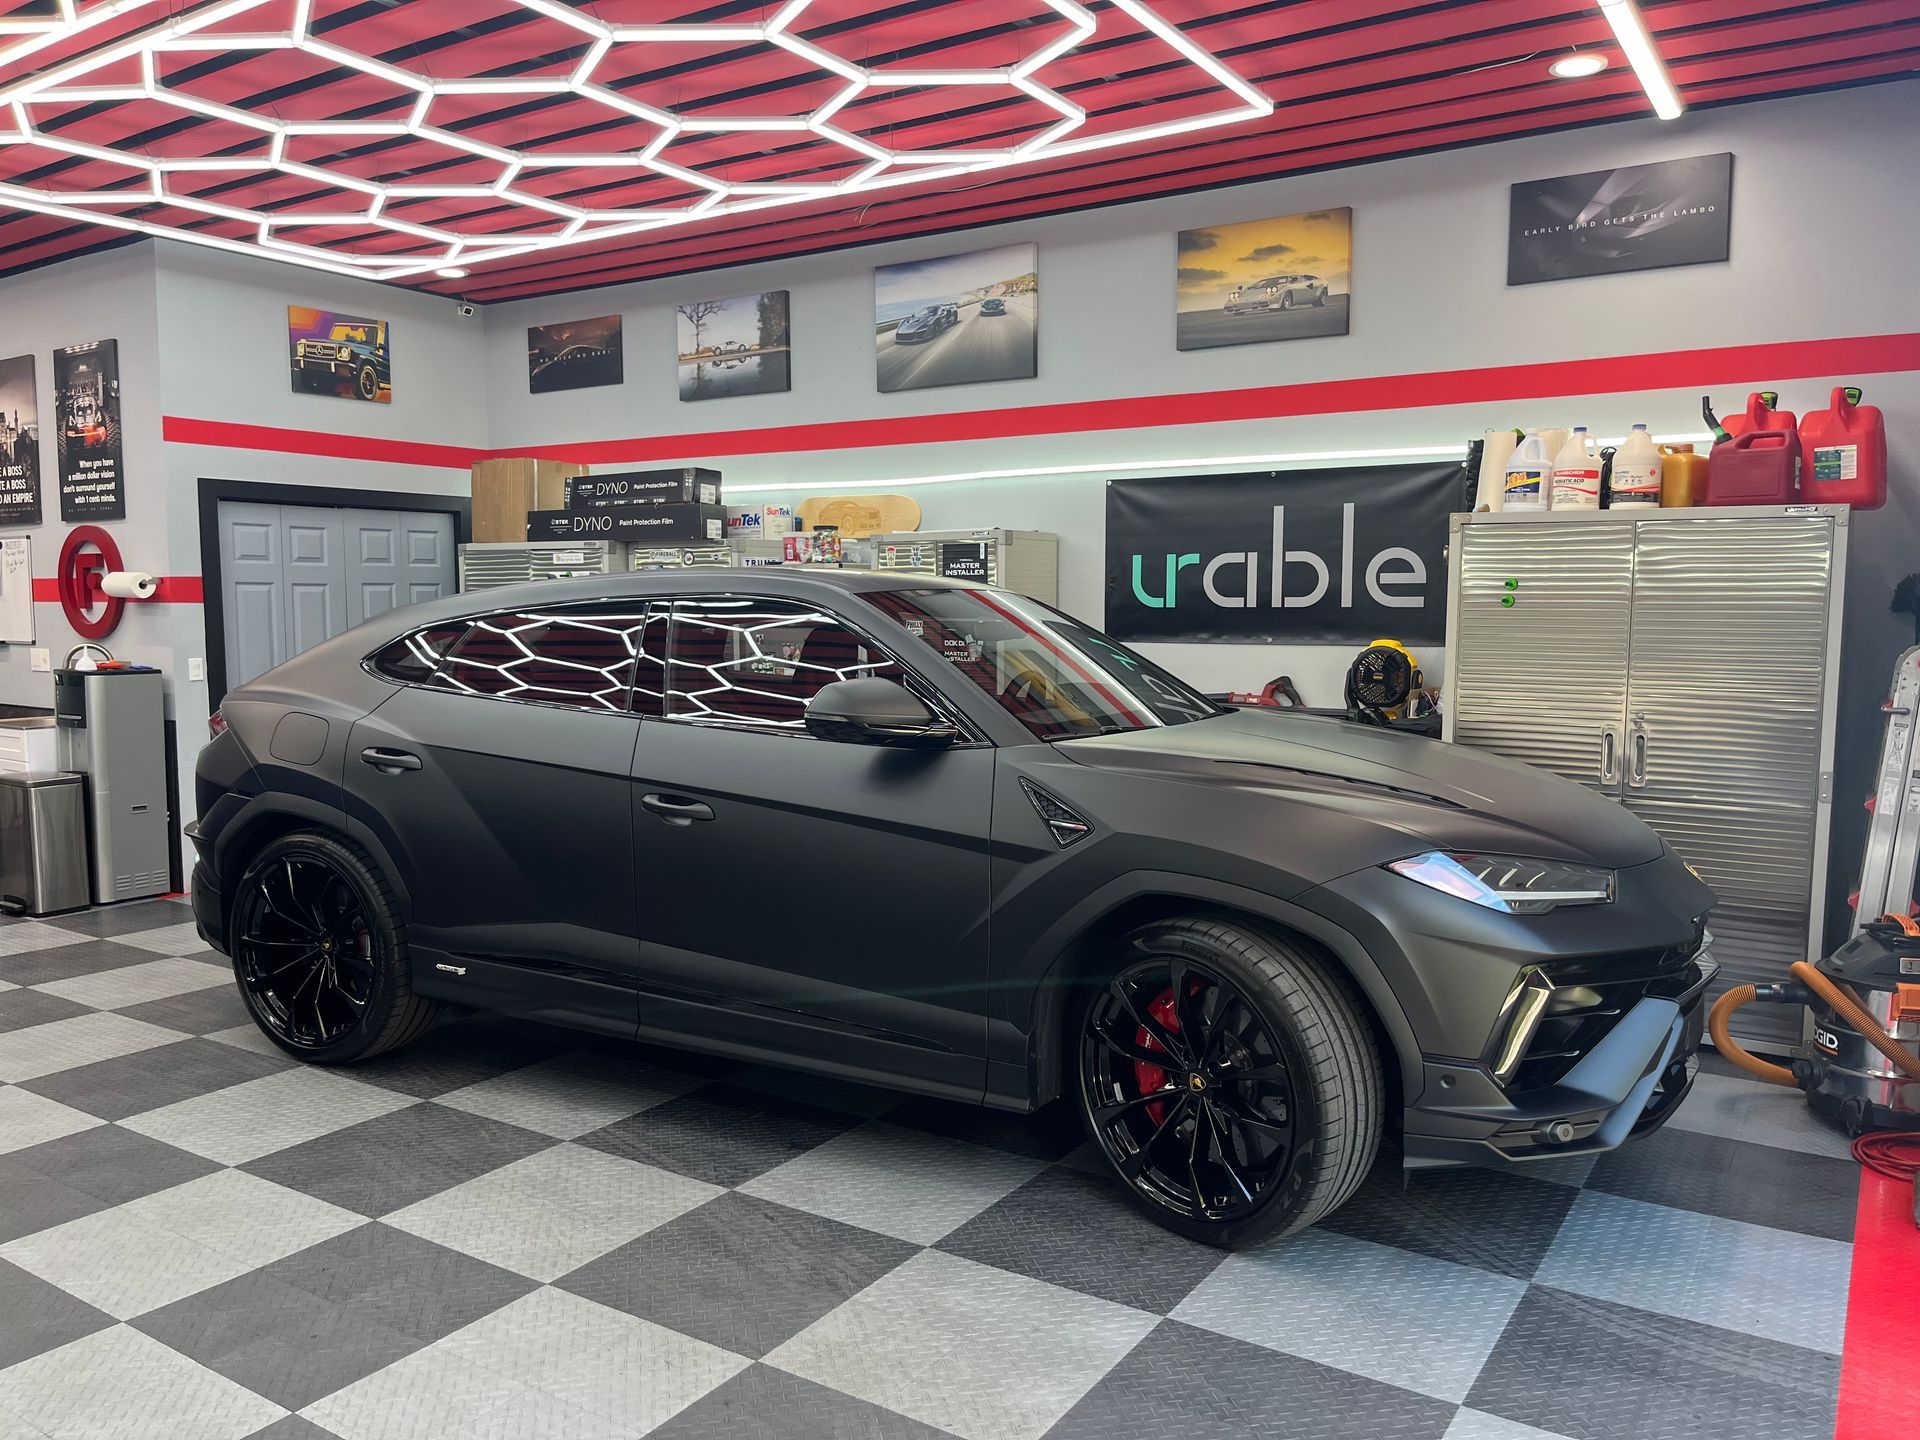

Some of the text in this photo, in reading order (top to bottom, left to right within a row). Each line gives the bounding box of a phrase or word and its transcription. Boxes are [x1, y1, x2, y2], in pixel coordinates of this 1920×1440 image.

[1524, 205, 1715, 236] EARLY BIRD GETS THE LAMBO
[79, 458, 114, 469] When you have
[7, 465, 23, 477] BOSS
[72, 472, 86, 481] million
[87, 470, 100, 479] dollar
[100, 470, 115, 478] vision
[11, 478, 27, 490] BOSS
[76, 483, 96, 492] surround
[96, 481, 116, 493] yourself
[597, 481, 629, 496] DYNO
[646, 481, 668, 489] Protection
[668, 480, 678, 488] Film
[3, 493, 12, 504] AN
[12, 492, 34, 504] EMPIRE
[74, 495, 86, 504] with
[89, 495, 100, 503] cent
[766, 507, 791, 516] SunTek
[574, 515, 612, 532] DYNO
[633, 518, 661, 526] Protection
[727, 513, 761, 527] unTek
[1132, 502, 1428, 608] urable
